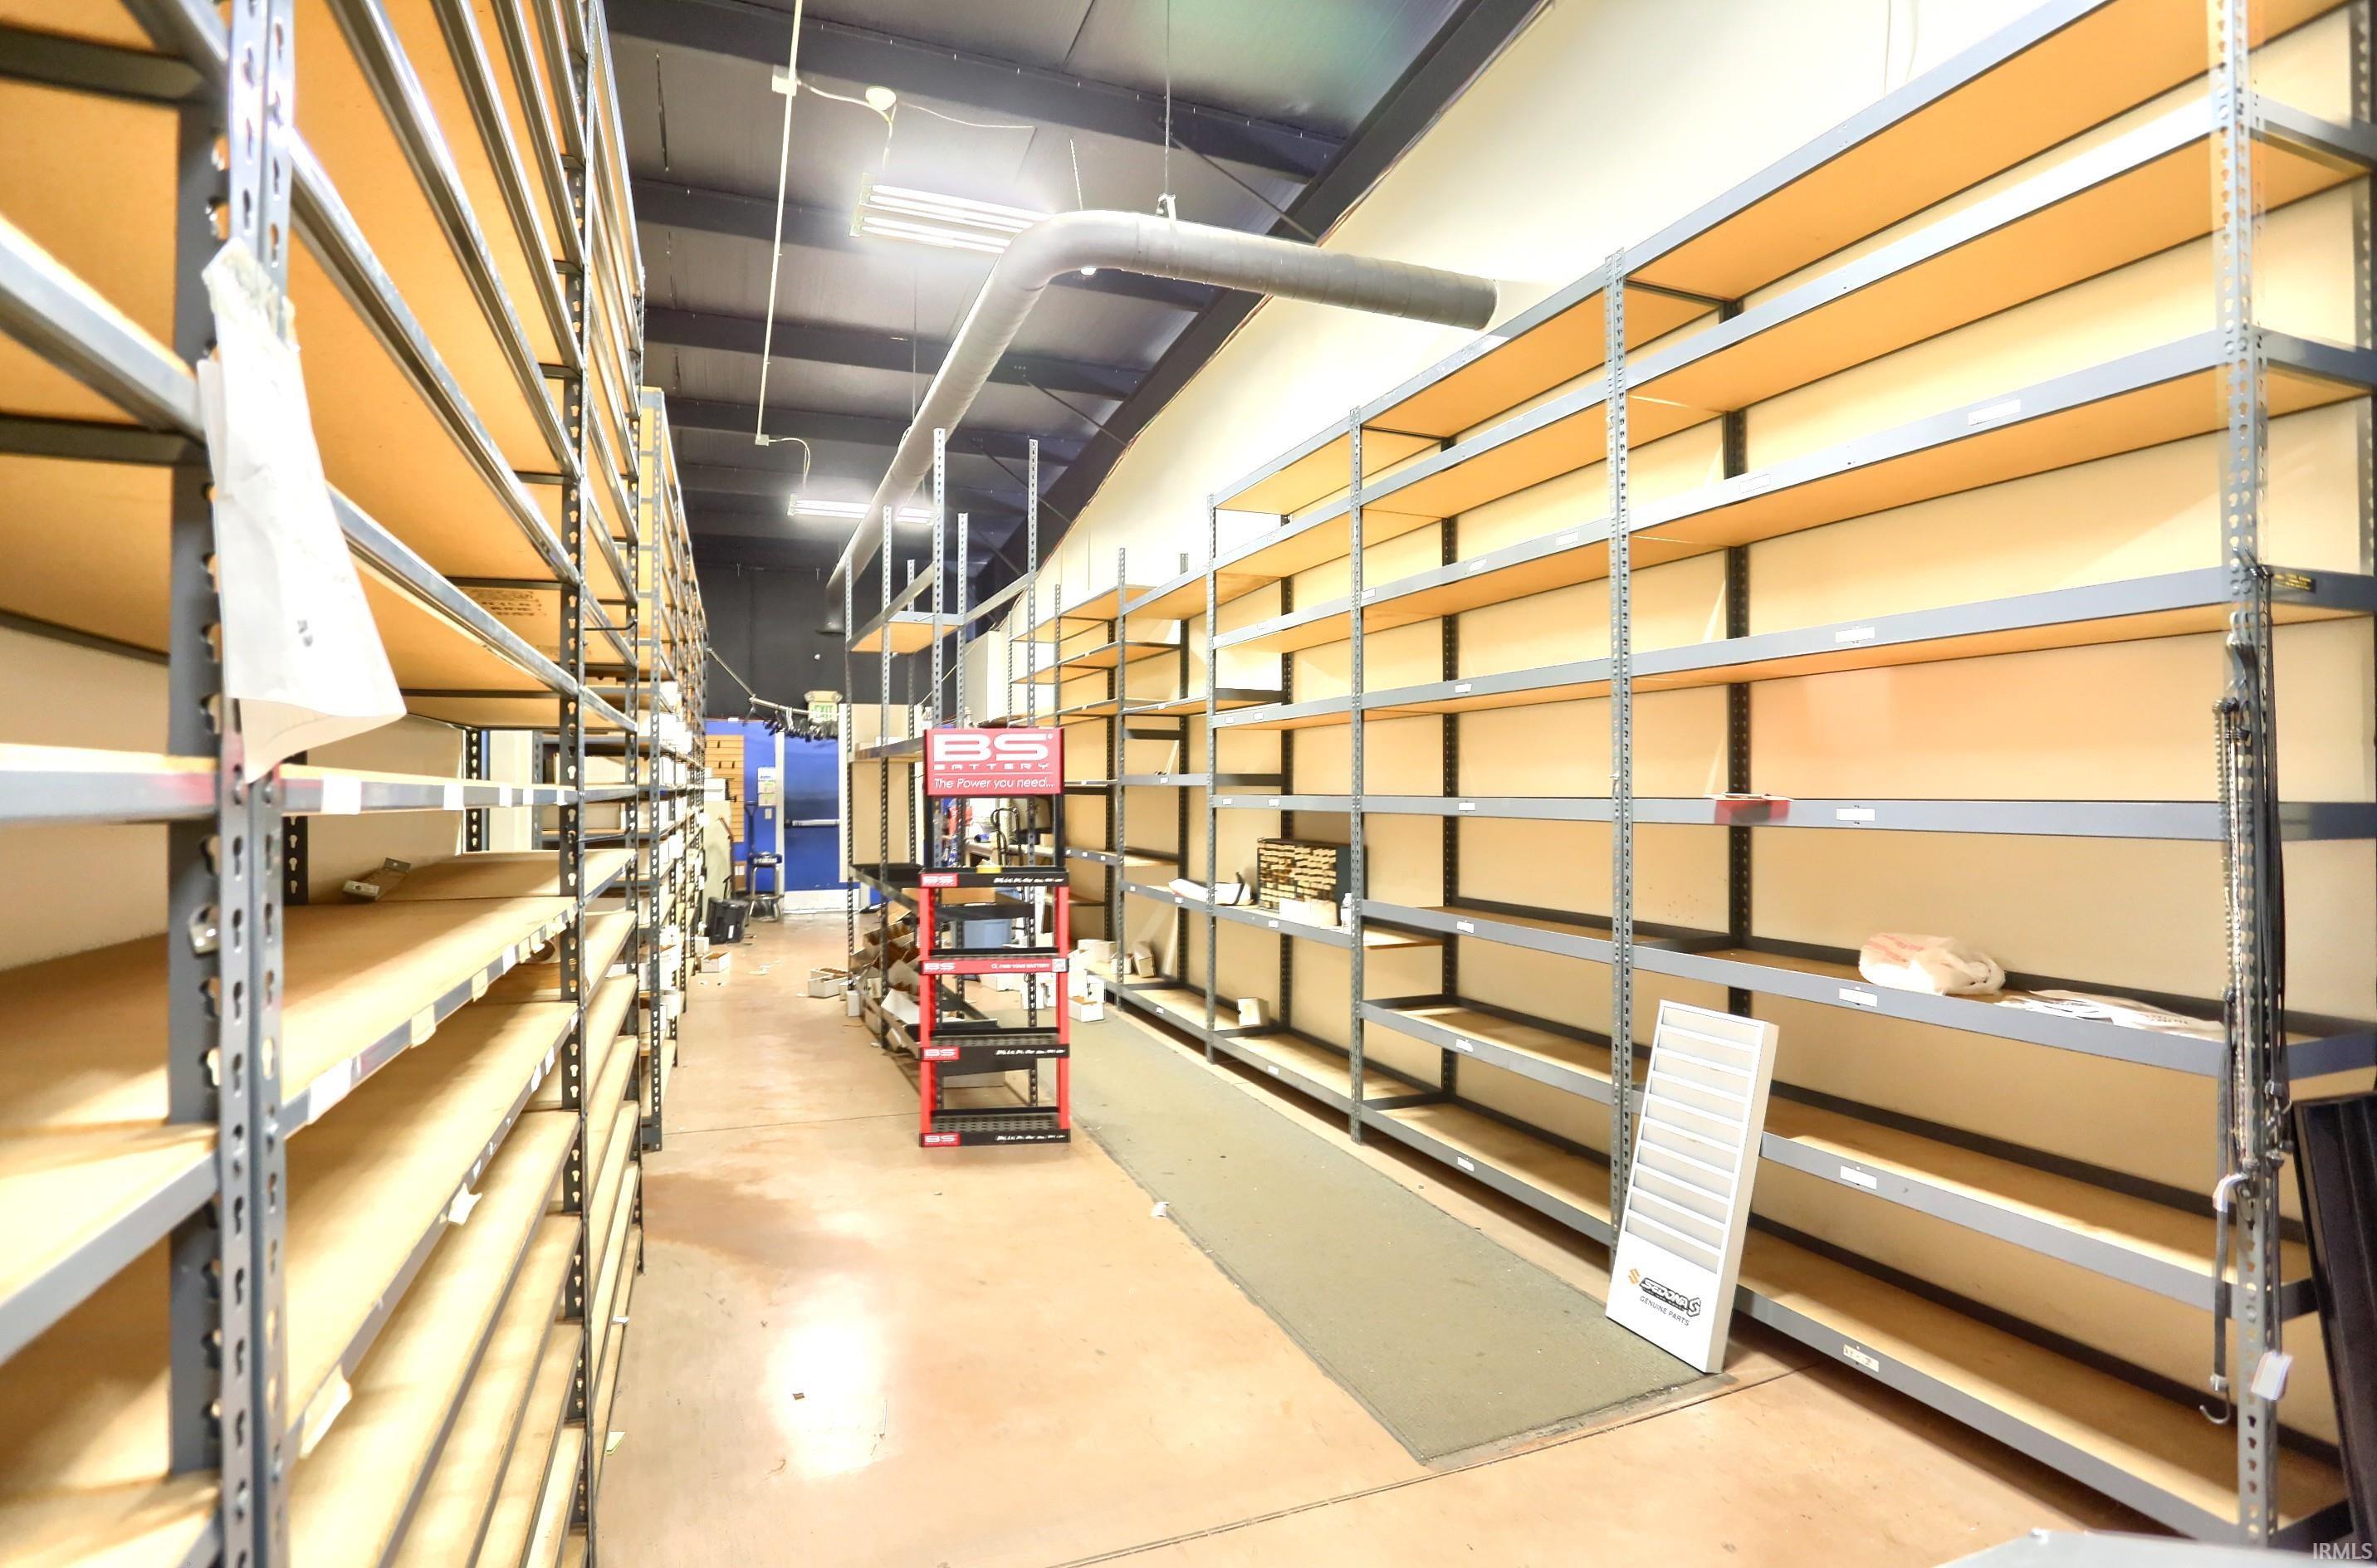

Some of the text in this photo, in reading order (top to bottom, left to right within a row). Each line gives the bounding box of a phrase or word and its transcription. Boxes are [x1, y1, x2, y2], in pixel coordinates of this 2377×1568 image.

[933, 734, 1049, 761] BS
[934, 779, 953, 789] The
[956, 777, 990, 789] Power
[994, 779, 1014, 790] you
[923, 962, 956, 970] BS
[923, 1048, 955, 1057] BS
[924, 1135, 955, 1143] BS
[1640, 1296, 1668, 1315] GENUINE
[1668, 1311, 1690, 1326] PARTS
